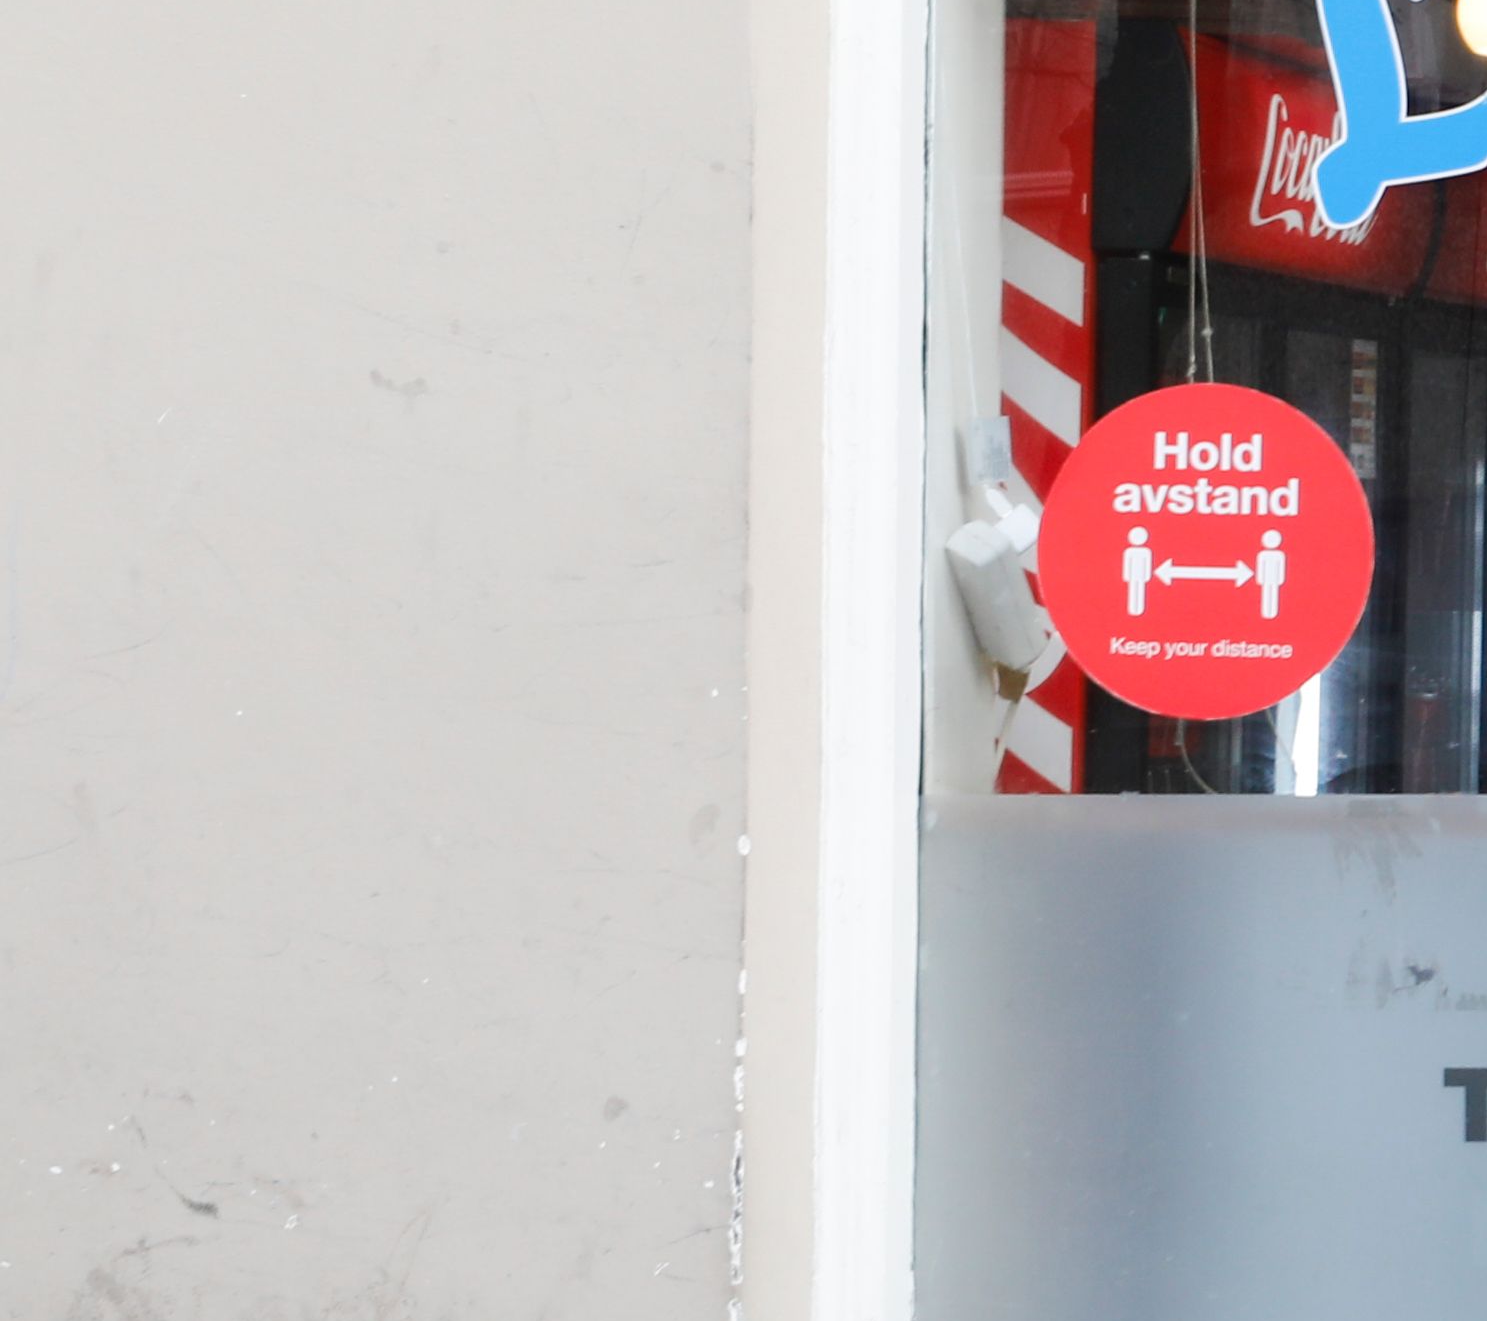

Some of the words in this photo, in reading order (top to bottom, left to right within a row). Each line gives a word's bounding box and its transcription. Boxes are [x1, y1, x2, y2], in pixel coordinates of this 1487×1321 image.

[1152, 431, 1264, 473] Hold
[1112, 478, 1300, 518] avstand
[1109, 635, 1161, 661] Keep
[1163, 640, 1207, 661] your
[1210, 637, 1294, 660] distance
